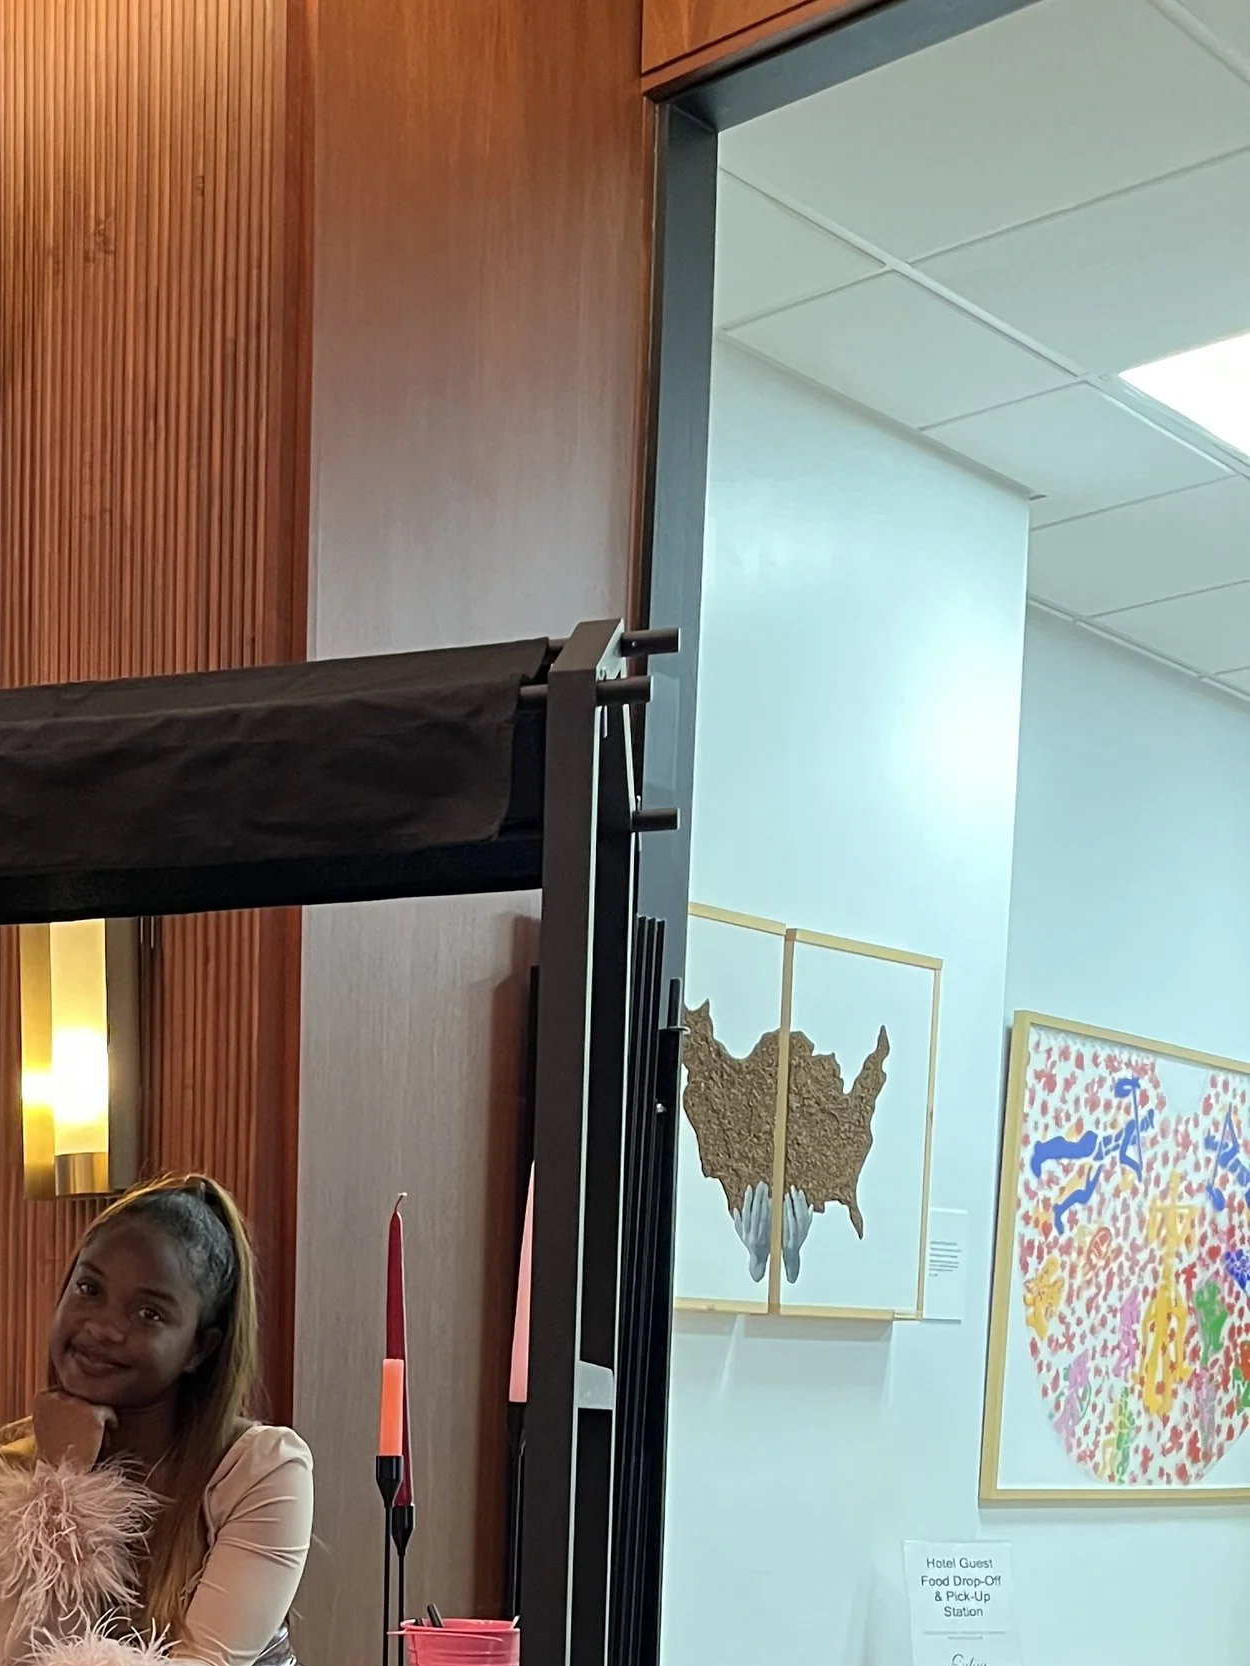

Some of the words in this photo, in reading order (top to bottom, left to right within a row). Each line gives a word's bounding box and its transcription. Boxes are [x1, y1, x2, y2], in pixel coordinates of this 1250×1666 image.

[926, 1557, 956, 1569] Hotel
[959, 1557, 993, 1569] Guest
[921, 1575, 950, 1587] Food
[953, 1575, 1002, 1588] Drop-Off
[934, 1591, 943, 1602] &
[946, 1590, 991, 1603] Pick-Up
[944, 1606, 984, 1618] Station
